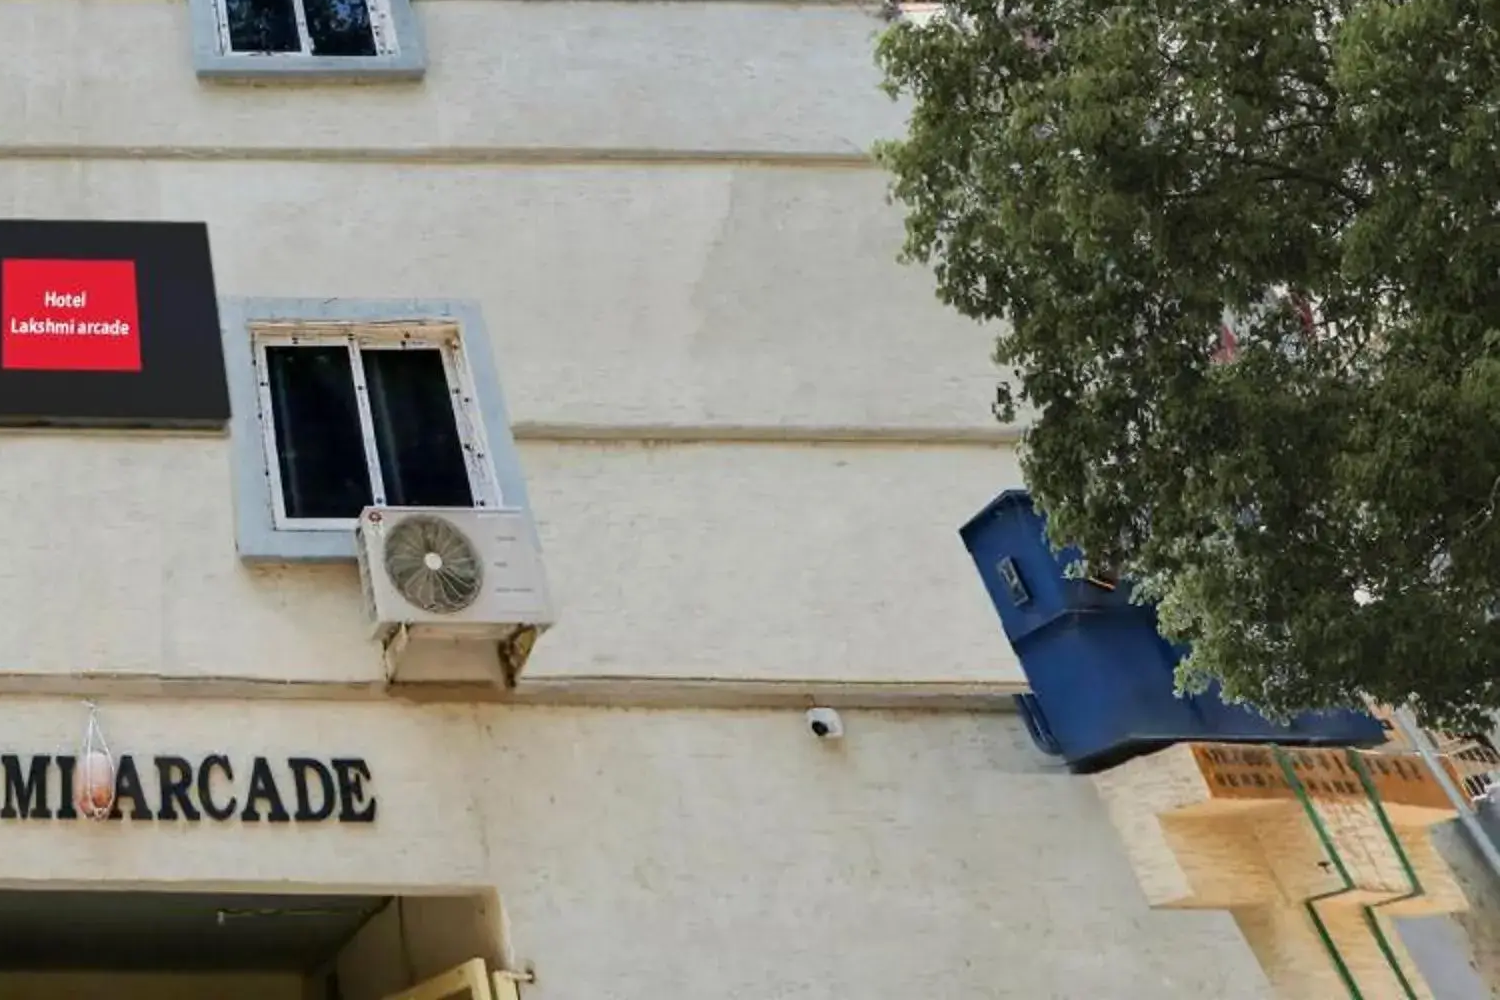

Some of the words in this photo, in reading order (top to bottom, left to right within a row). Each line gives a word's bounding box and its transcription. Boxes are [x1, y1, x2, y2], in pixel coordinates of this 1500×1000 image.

[45, 290, 87, 308] Hotel
[11, 317, 75, 335] Lakshmi
[77, 319, 130, 336] arcade
[107, 755, 377, 823] ARCADE
